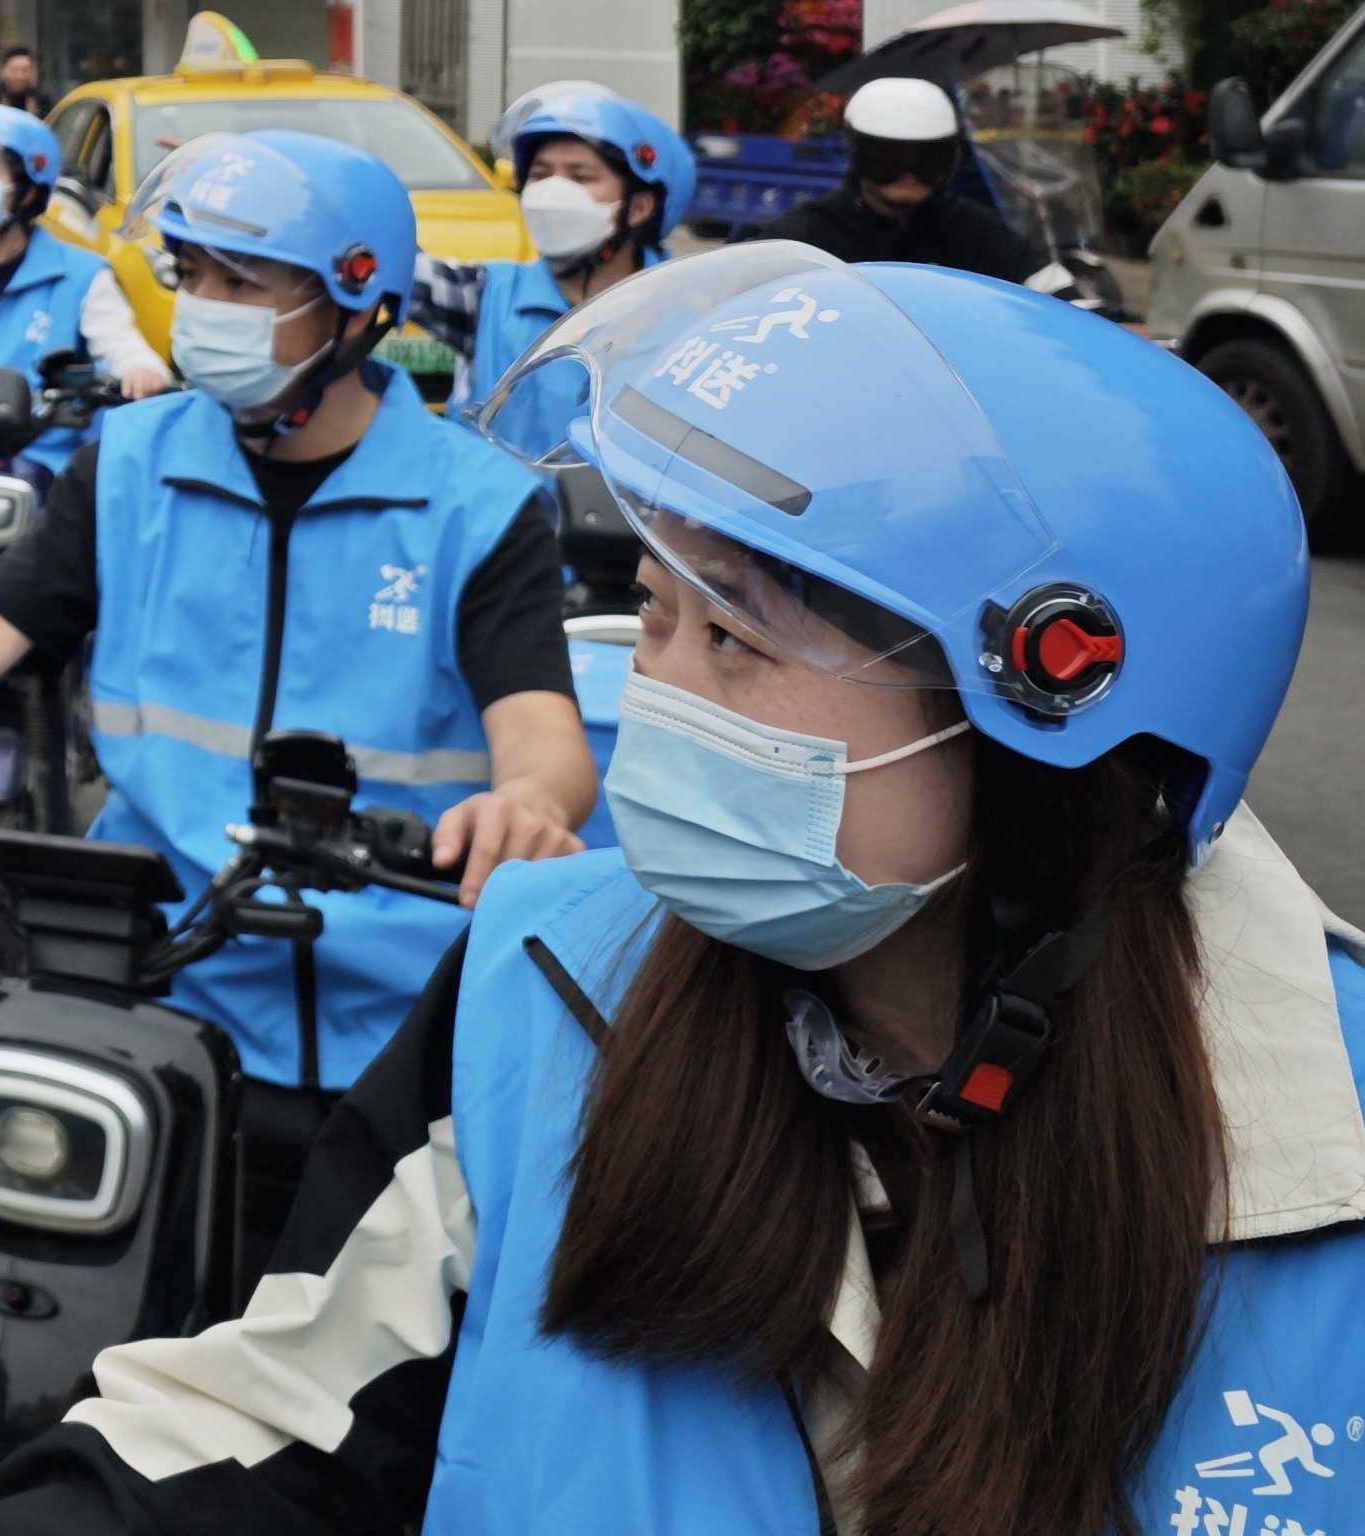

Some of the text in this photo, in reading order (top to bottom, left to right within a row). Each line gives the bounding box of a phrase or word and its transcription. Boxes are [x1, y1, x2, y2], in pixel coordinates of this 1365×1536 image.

[653, 336, 761, 410] 抖送
[368, 603, 418, 635] 抖送
[1170, 1485, 1327, 1536] 抖
